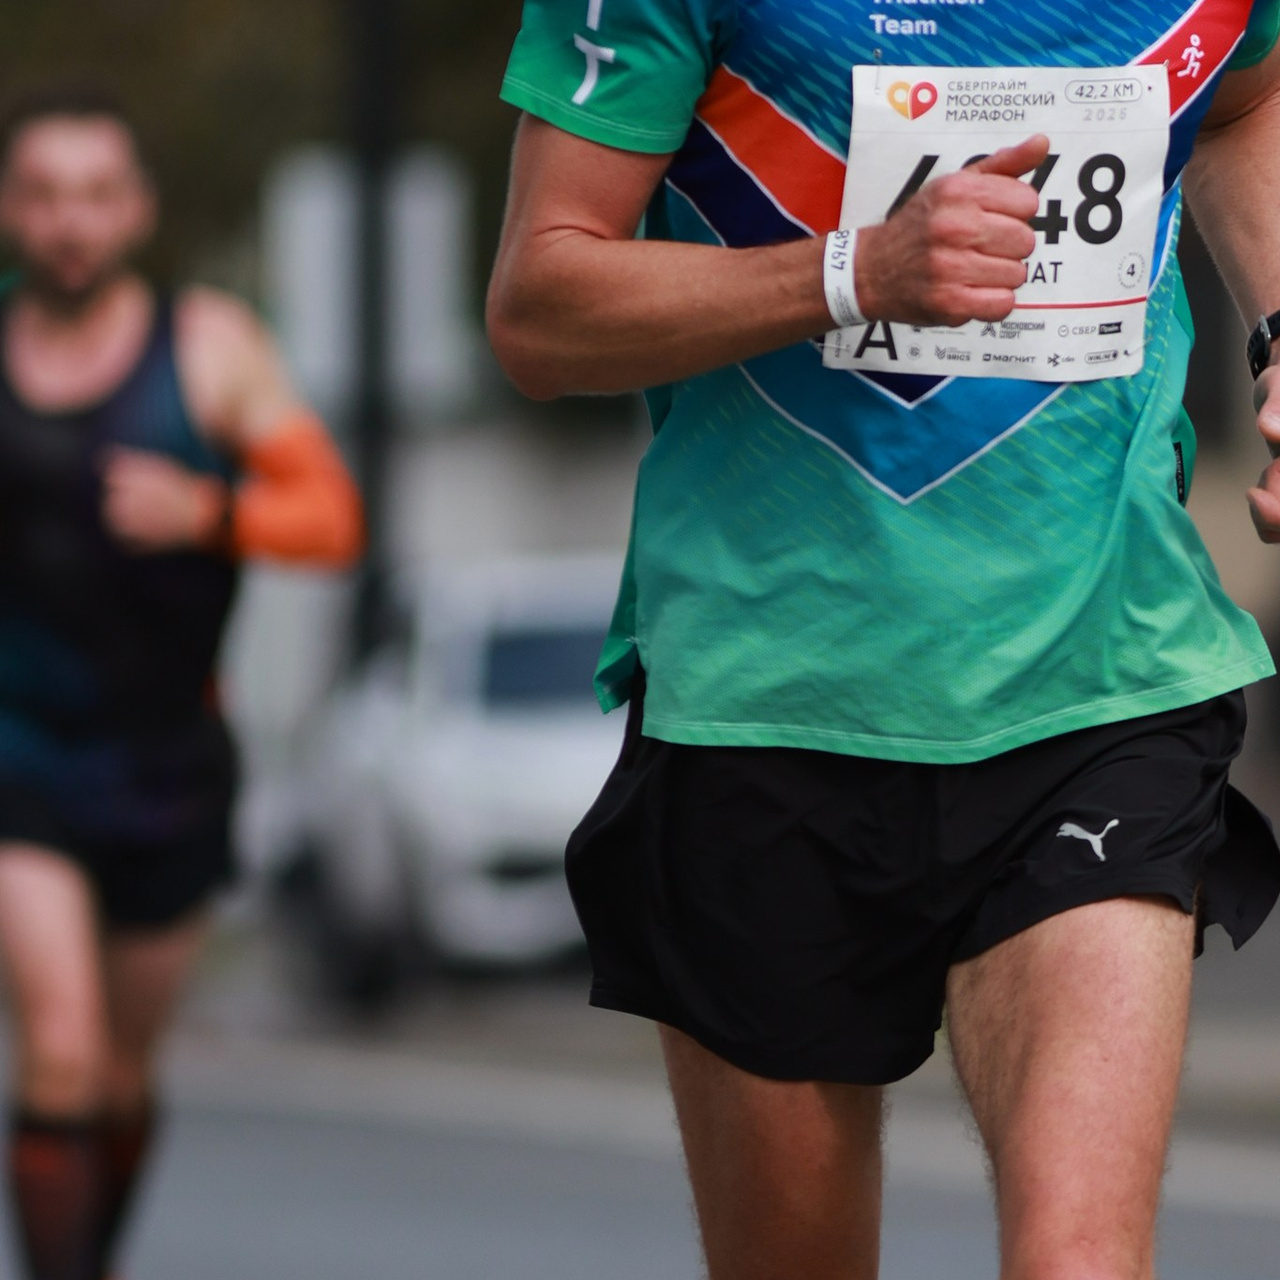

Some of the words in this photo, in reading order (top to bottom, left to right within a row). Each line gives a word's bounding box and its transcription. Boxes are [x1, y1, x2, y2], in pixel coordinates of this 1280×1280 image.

[869, 14, 938, 36] Team
[946, 79, 1028, 92] СБЕРПРАЙМ
[1074, 84, 1108, 100] 42,2
[1112, 83, 1134, 98] КМ
[946, 91, 1056, 107] МОСКОВСКИЙ
[945, 108, 1026, 122] МАРАФОН
[830, 229, 850, 271] 4948
[1126, 263, 1136, 276] 4
[1071, 326, 1097, 336] СБЕР
